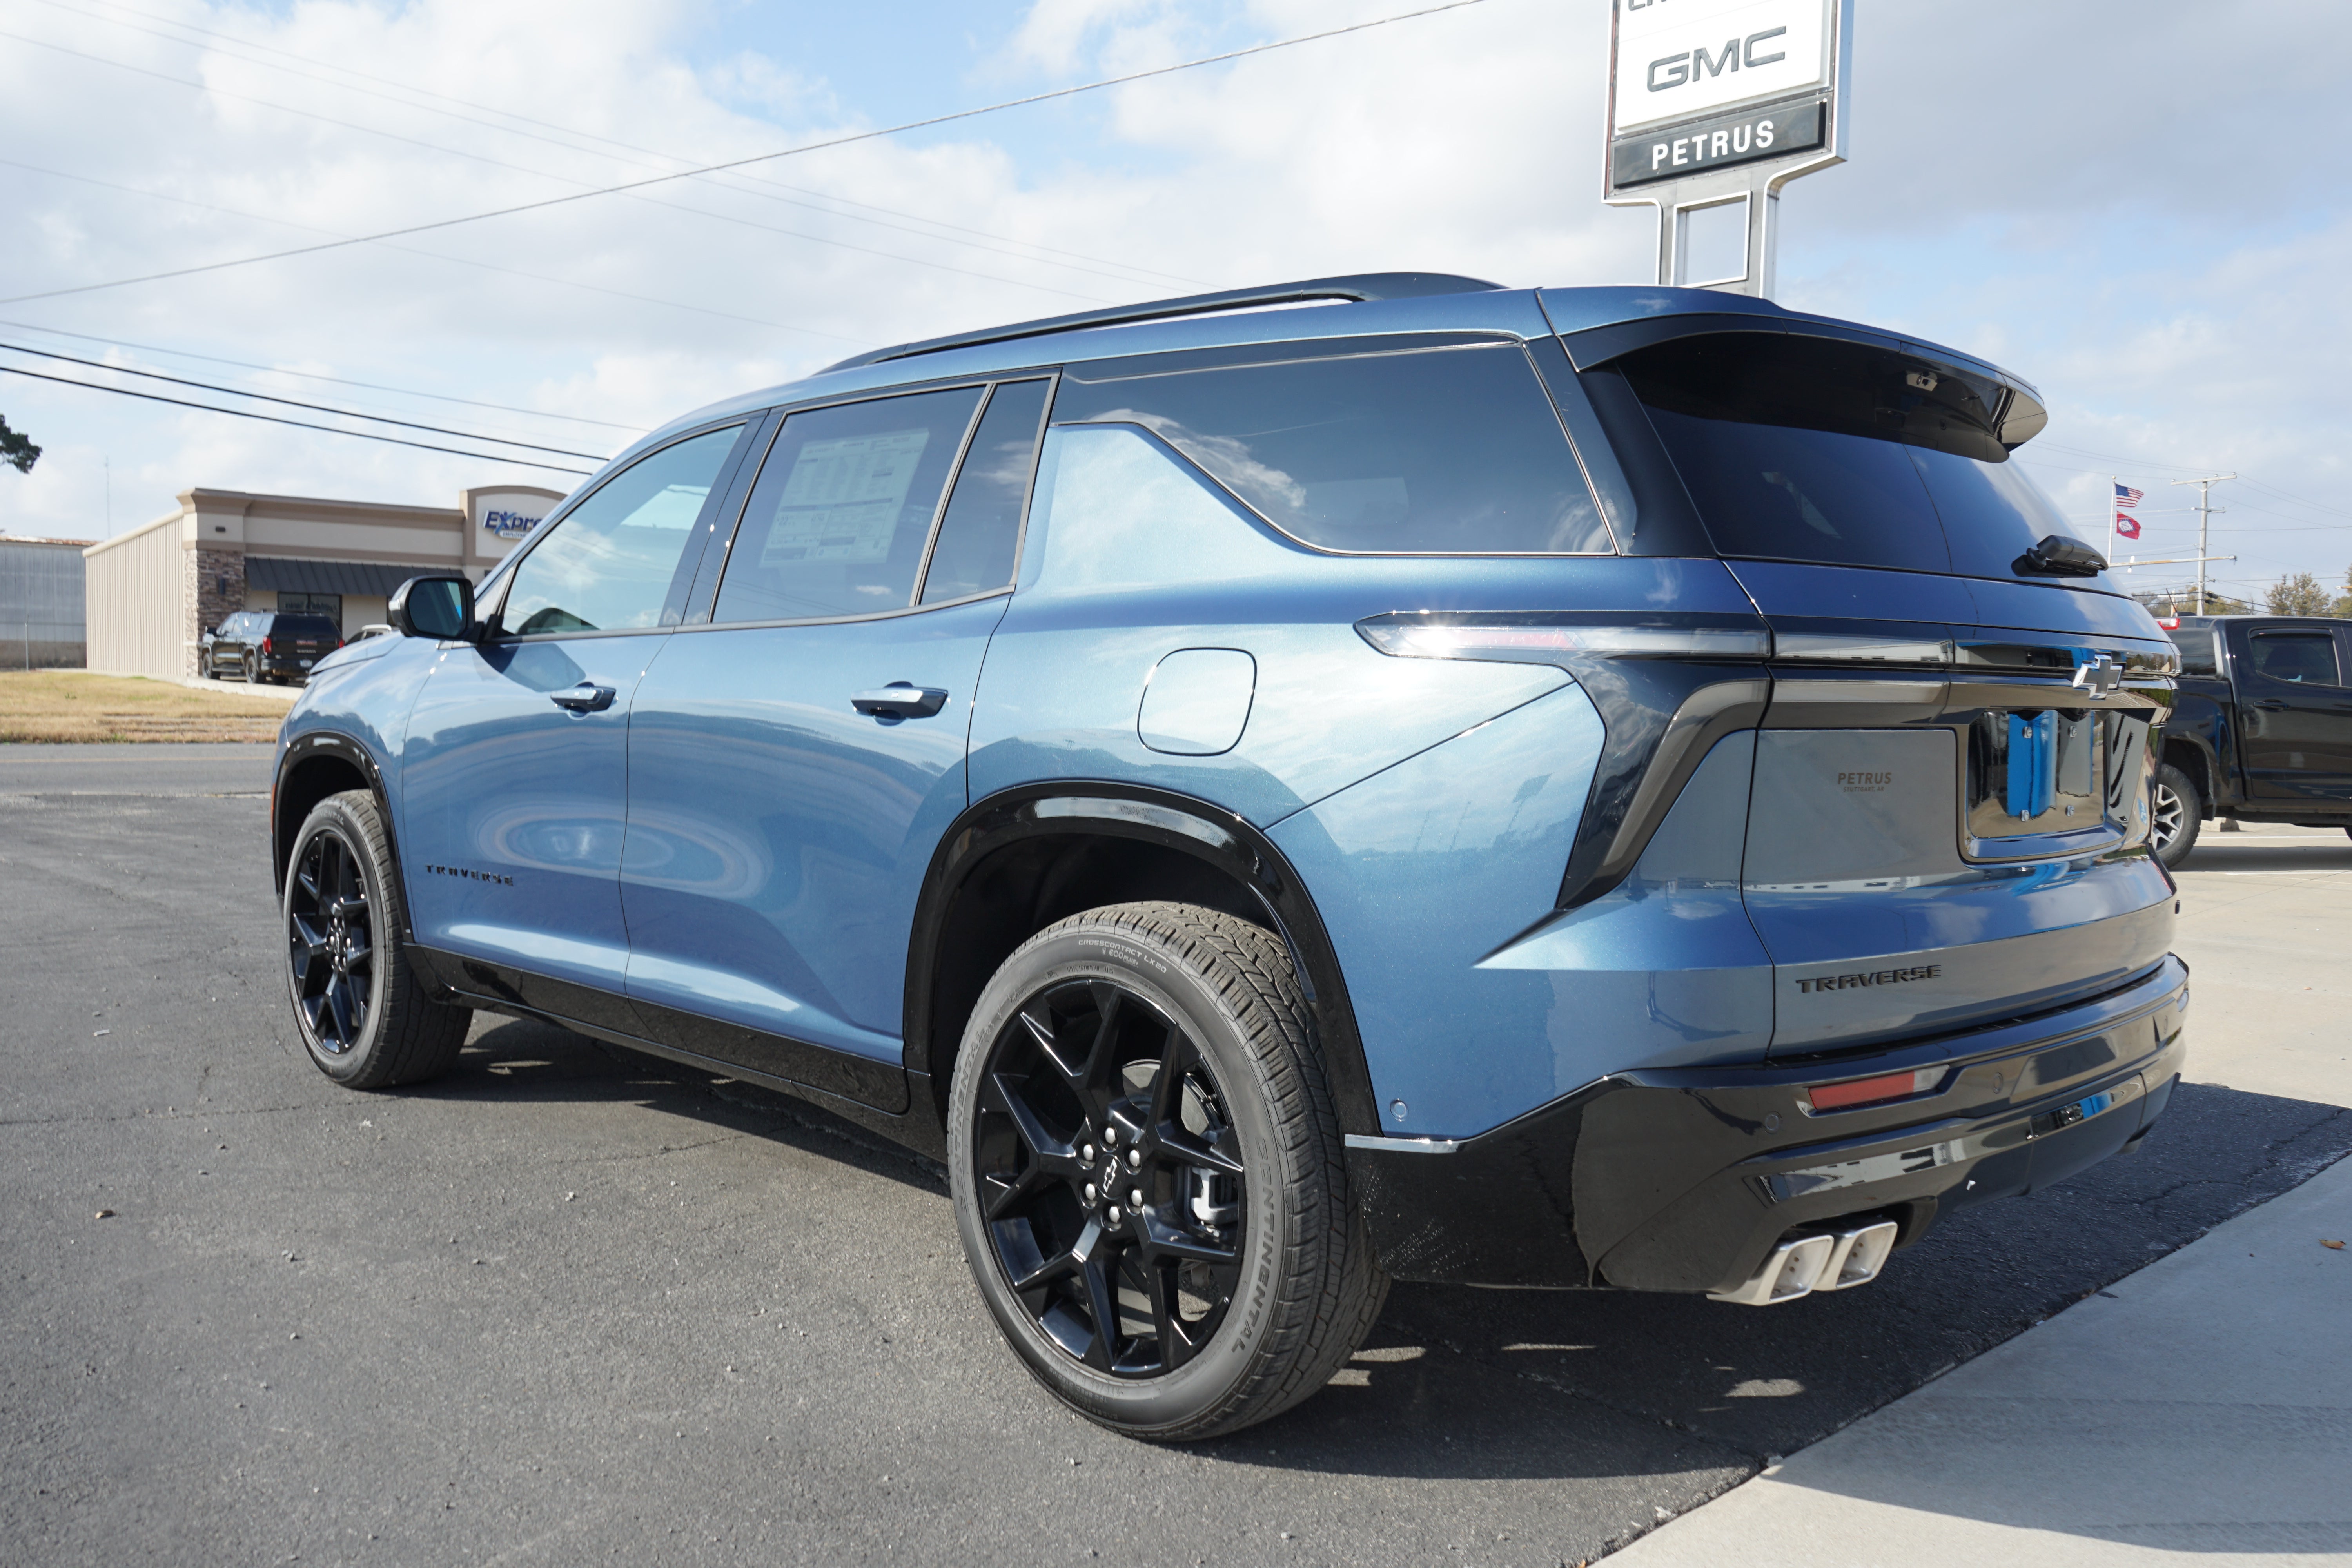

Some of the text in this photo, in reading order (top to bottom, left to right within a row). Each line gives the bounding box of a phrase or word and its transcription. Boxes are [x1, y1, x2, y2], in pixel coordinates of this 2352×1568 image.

[1647, 25, 1786, 92] GMC
[1652, 120, 1773, 170] PETRUS
[1837, 772, 1892, 784] PETRUS
[426, 864, 513, 886] TRAVERSE
[1078, 939, 1142, 958] CROSSCONTACT
[1796, 965, 1942, 993] TRAVERSE
[1231, 1138, 1274, 1354] CONTINENTAL
